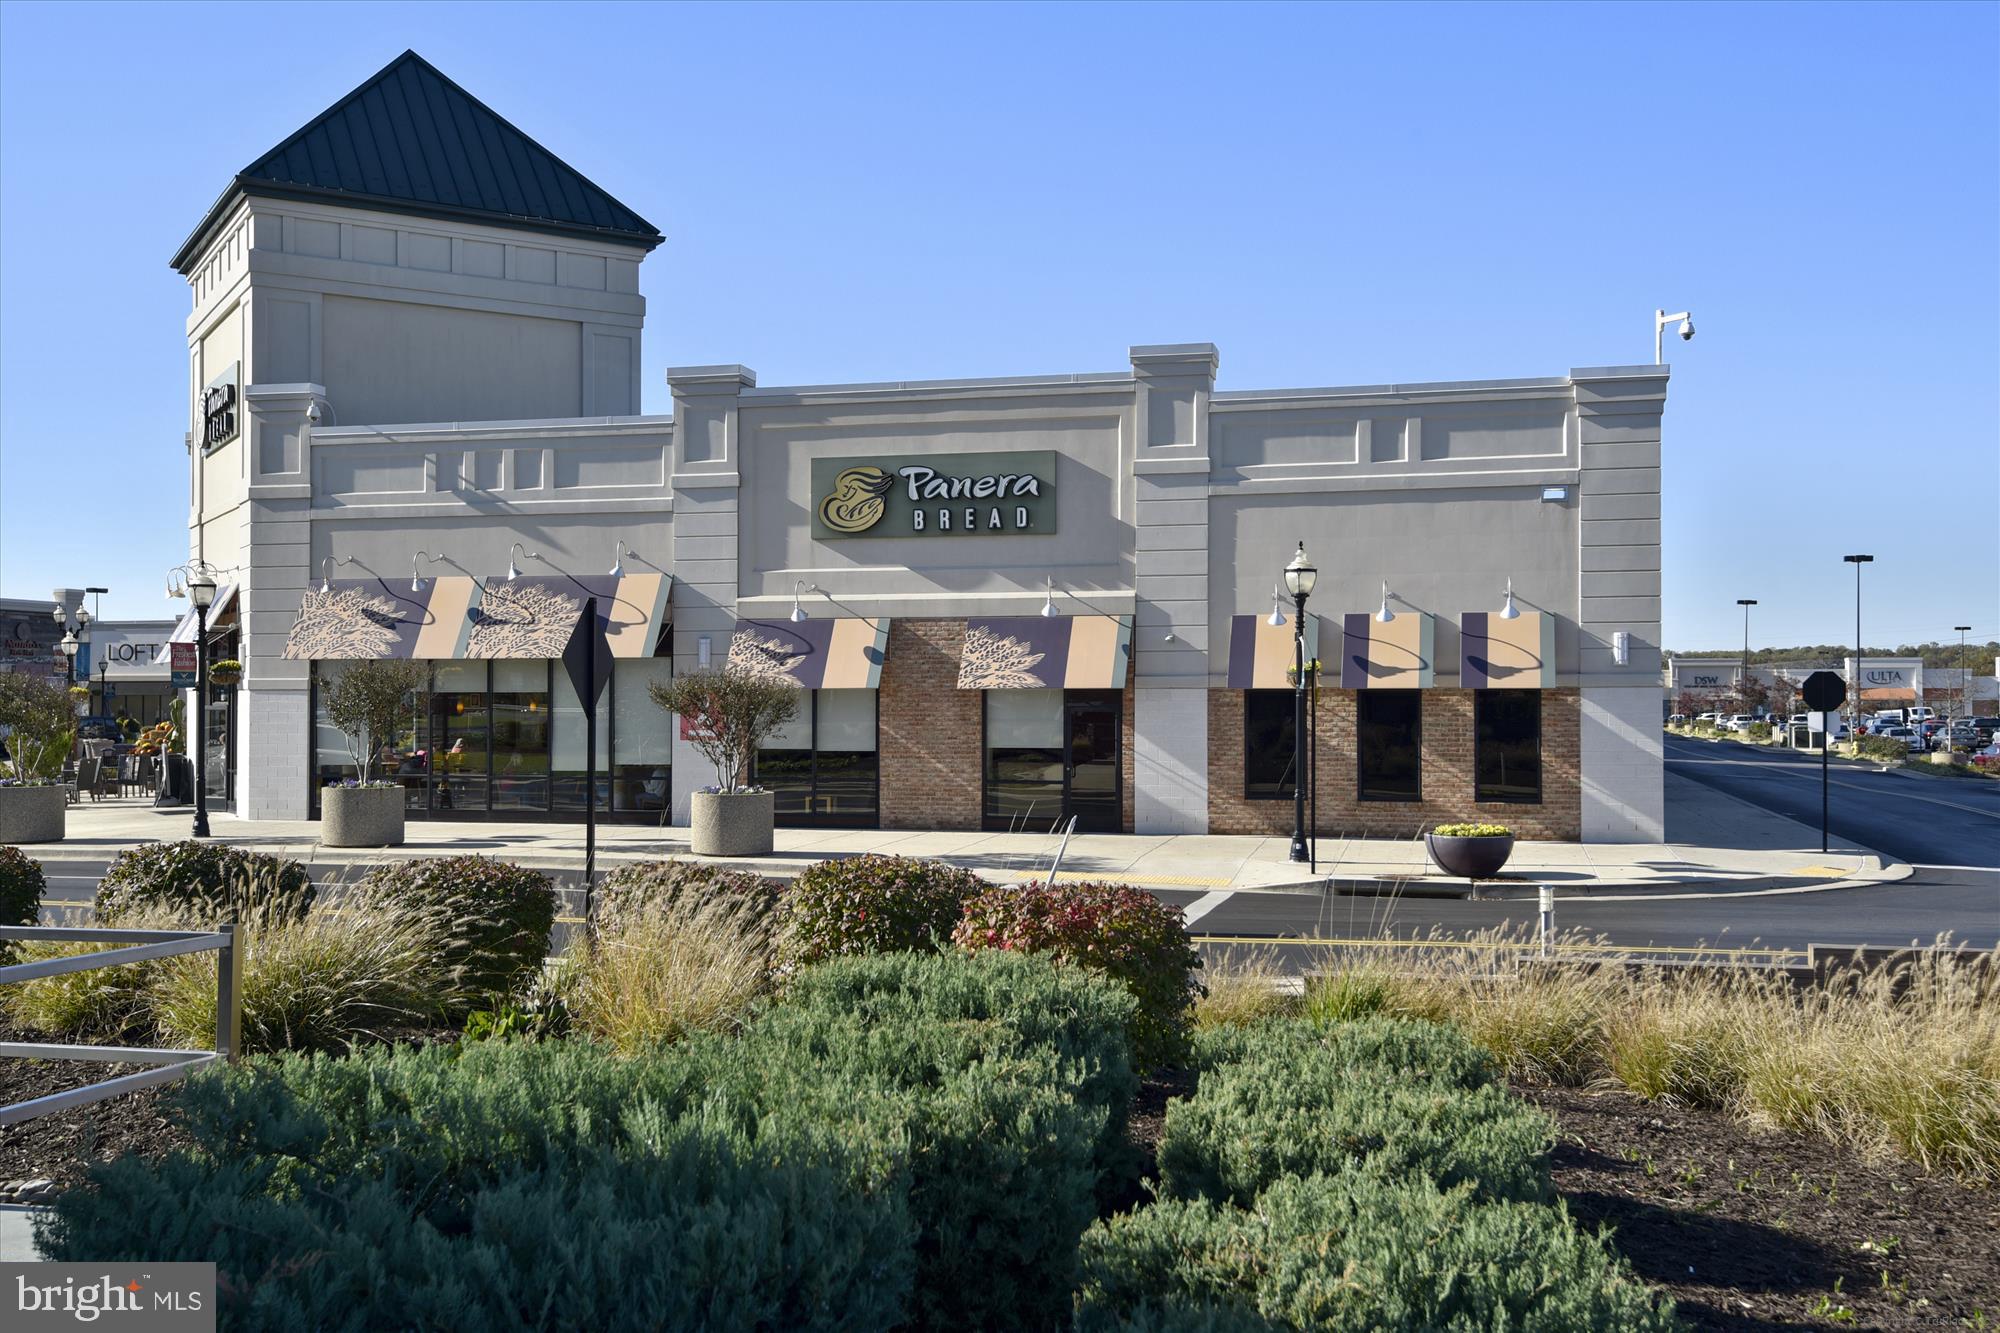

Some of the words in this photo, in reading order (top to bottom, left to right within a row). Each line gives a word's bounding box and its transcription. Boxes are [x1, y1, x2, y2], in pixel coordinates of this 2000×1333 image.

[898, 465, 1040, 501] Panera
[913, 506, 1029, 530] BREAD
[108, 643, 159, 661] LOFT
[1694, 676, 1718, 685] DSW
[1867, 671, 1902, 683] ULTA
